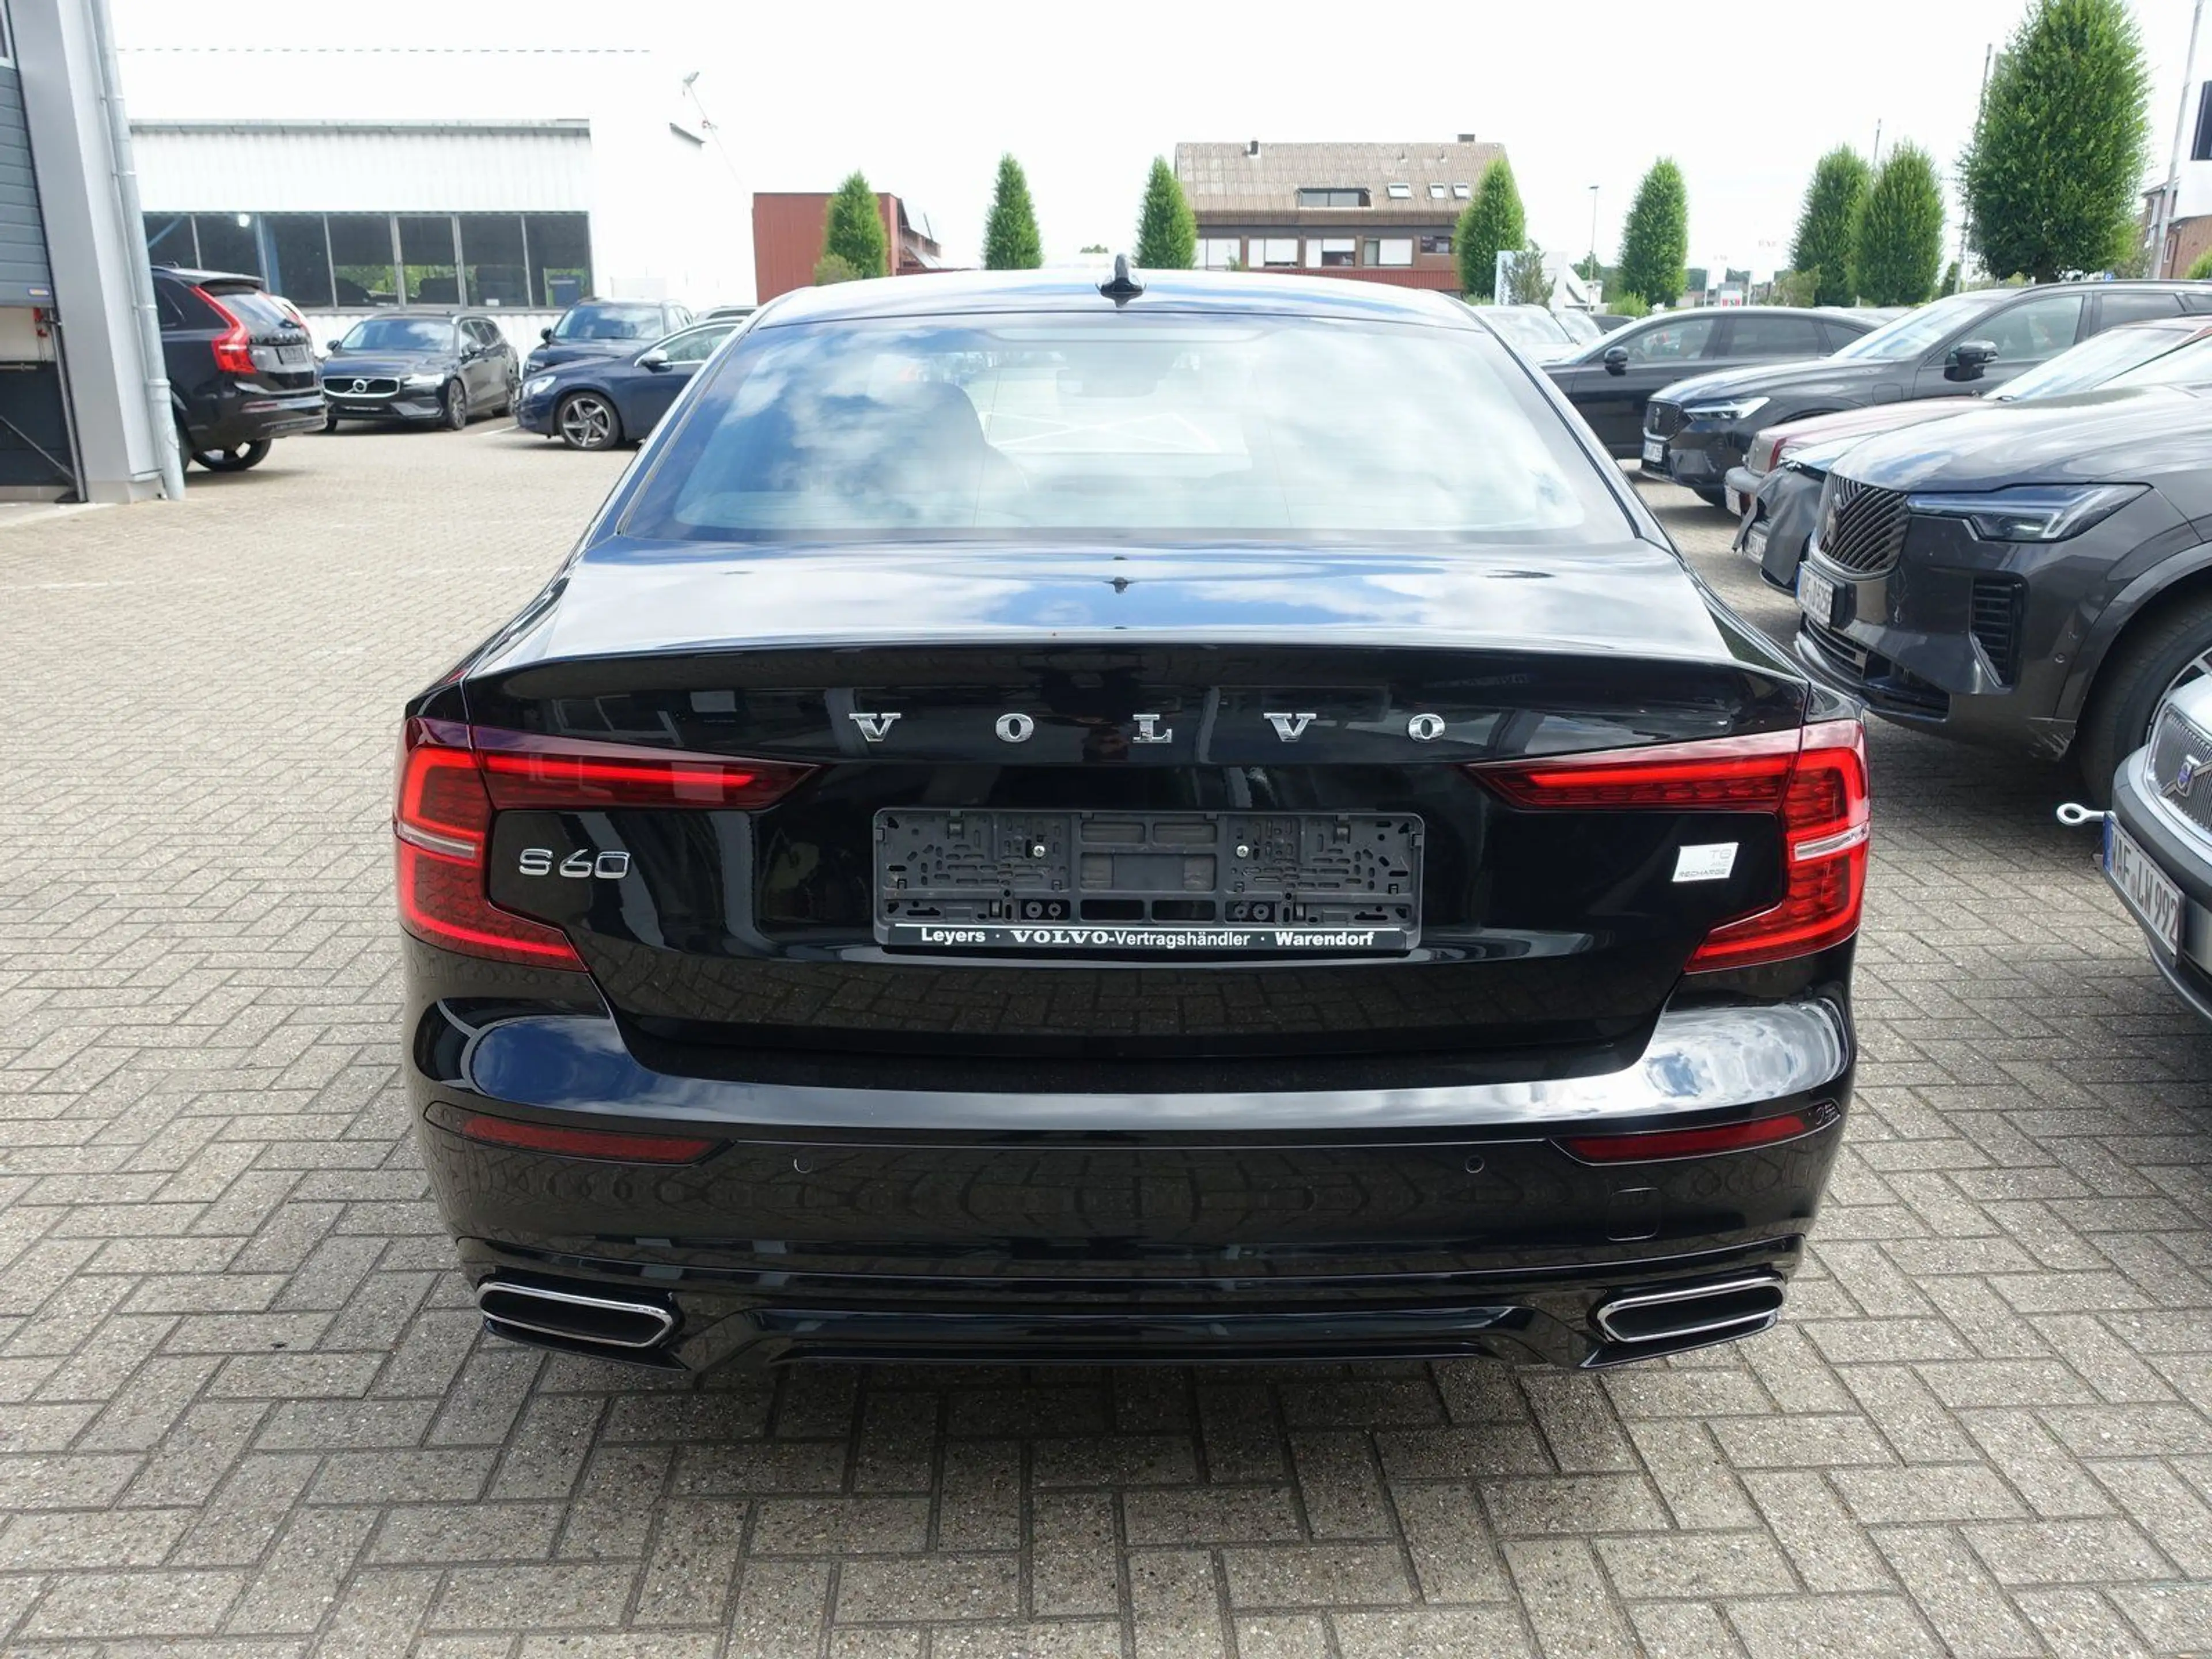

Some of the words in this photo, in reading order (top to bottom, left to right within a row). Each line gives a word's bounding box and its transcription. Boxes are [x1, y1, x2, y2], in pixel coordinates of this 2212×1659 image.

[849, 713, 1445, 743] VOLVO
[519, 848, 631, 879] S60
[1679, 868, 1727, 877] RECHARGE
[921, 927, 986, 945] Leyers
[1010, 929, 1251, 949] VOLVO-Vertragshändler
[1275, 931, 1374, 946] Warendorf
